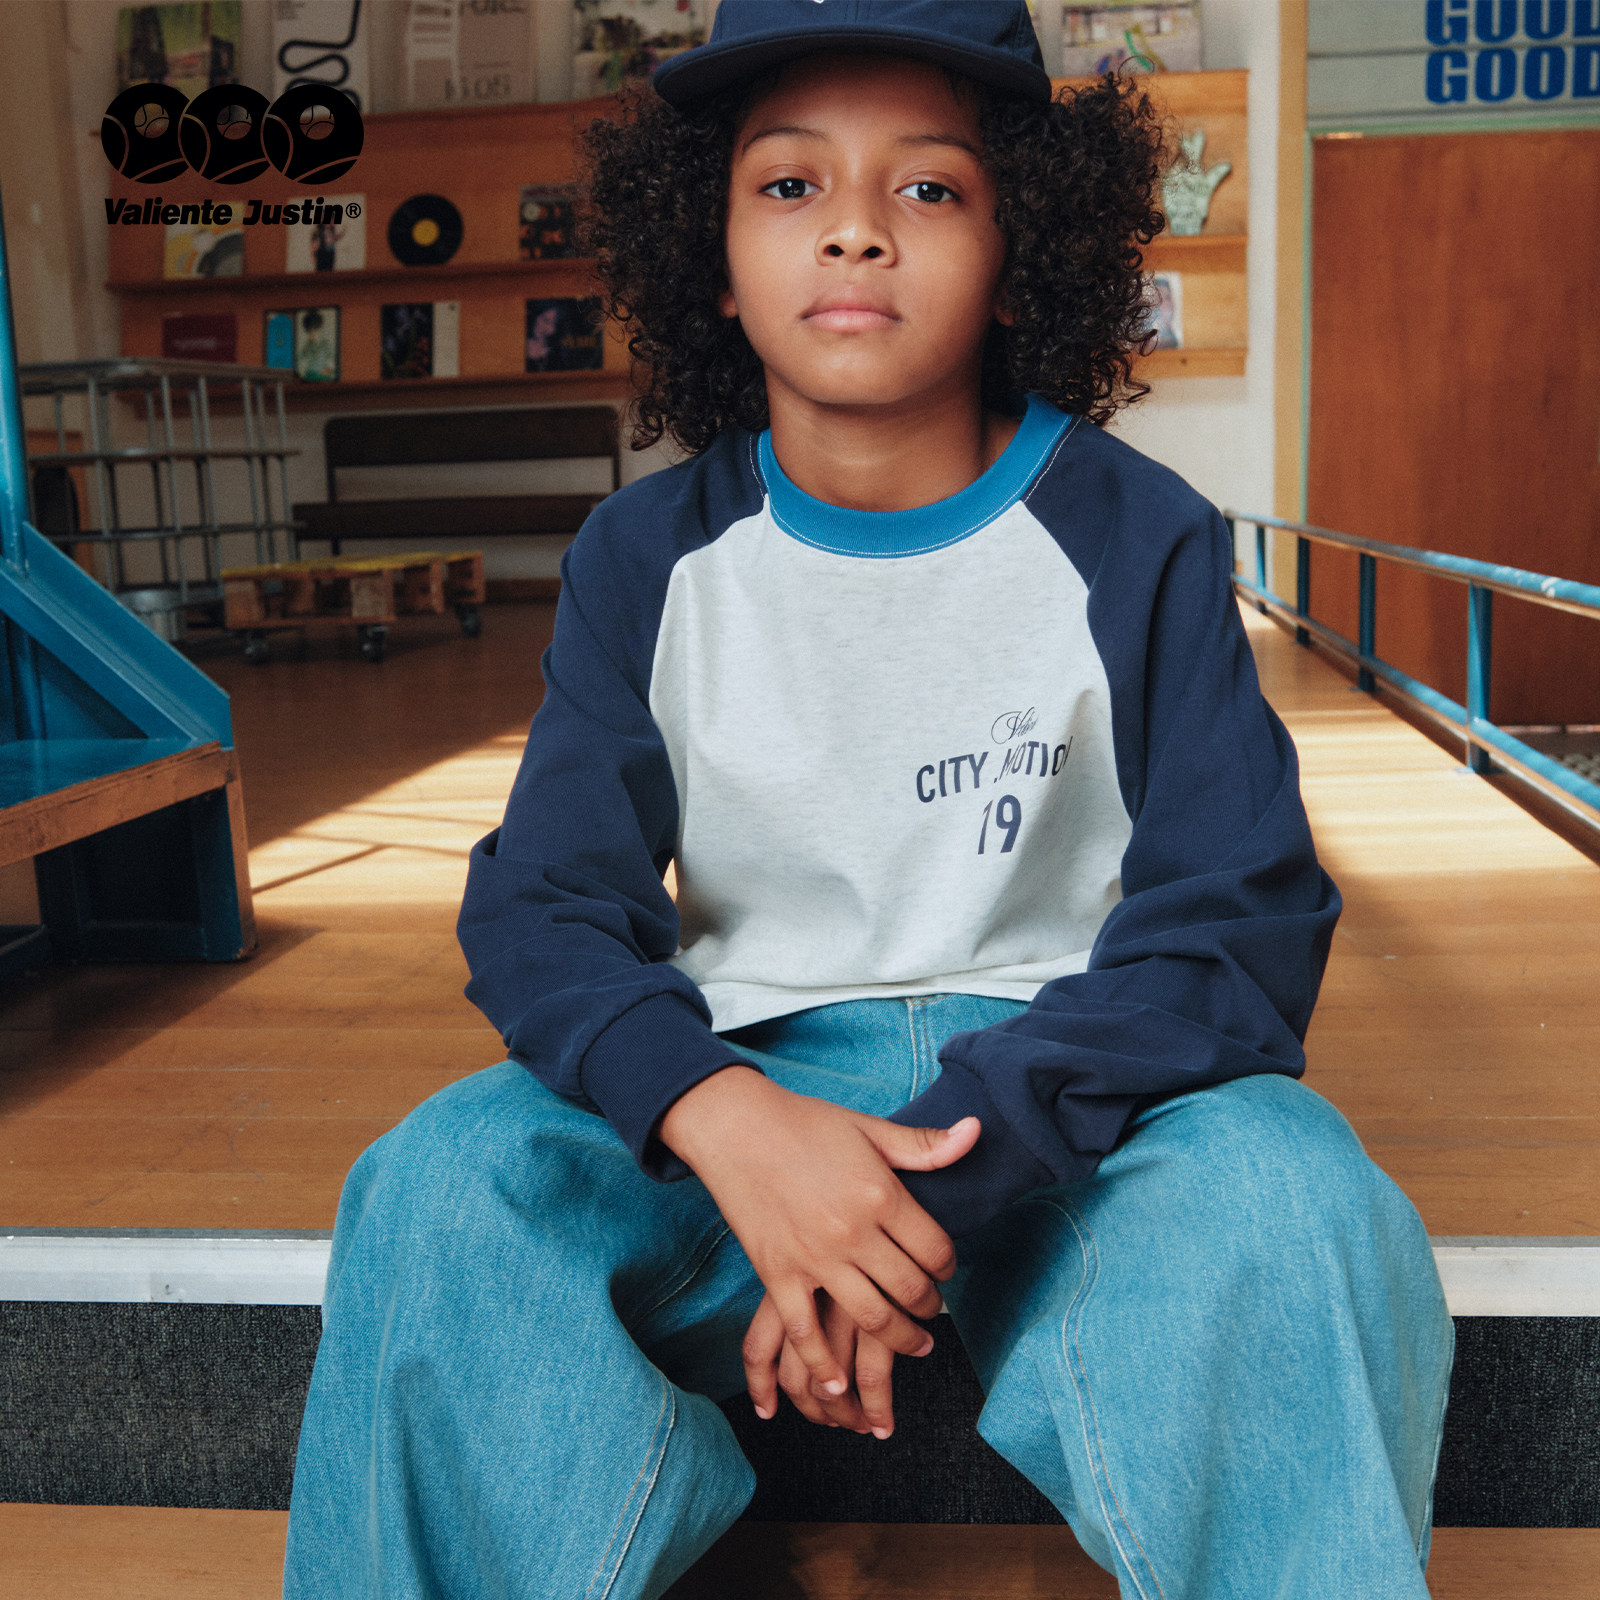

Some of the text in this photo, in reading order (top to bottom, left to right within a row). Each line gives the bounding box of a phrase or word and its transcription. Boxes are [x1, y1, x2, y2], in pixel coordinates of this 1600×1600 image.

[1426, 45, 1600, 104] GOOD
[916, 752, 989, 804] CITY
[978, 794, 1022, 855] 19
